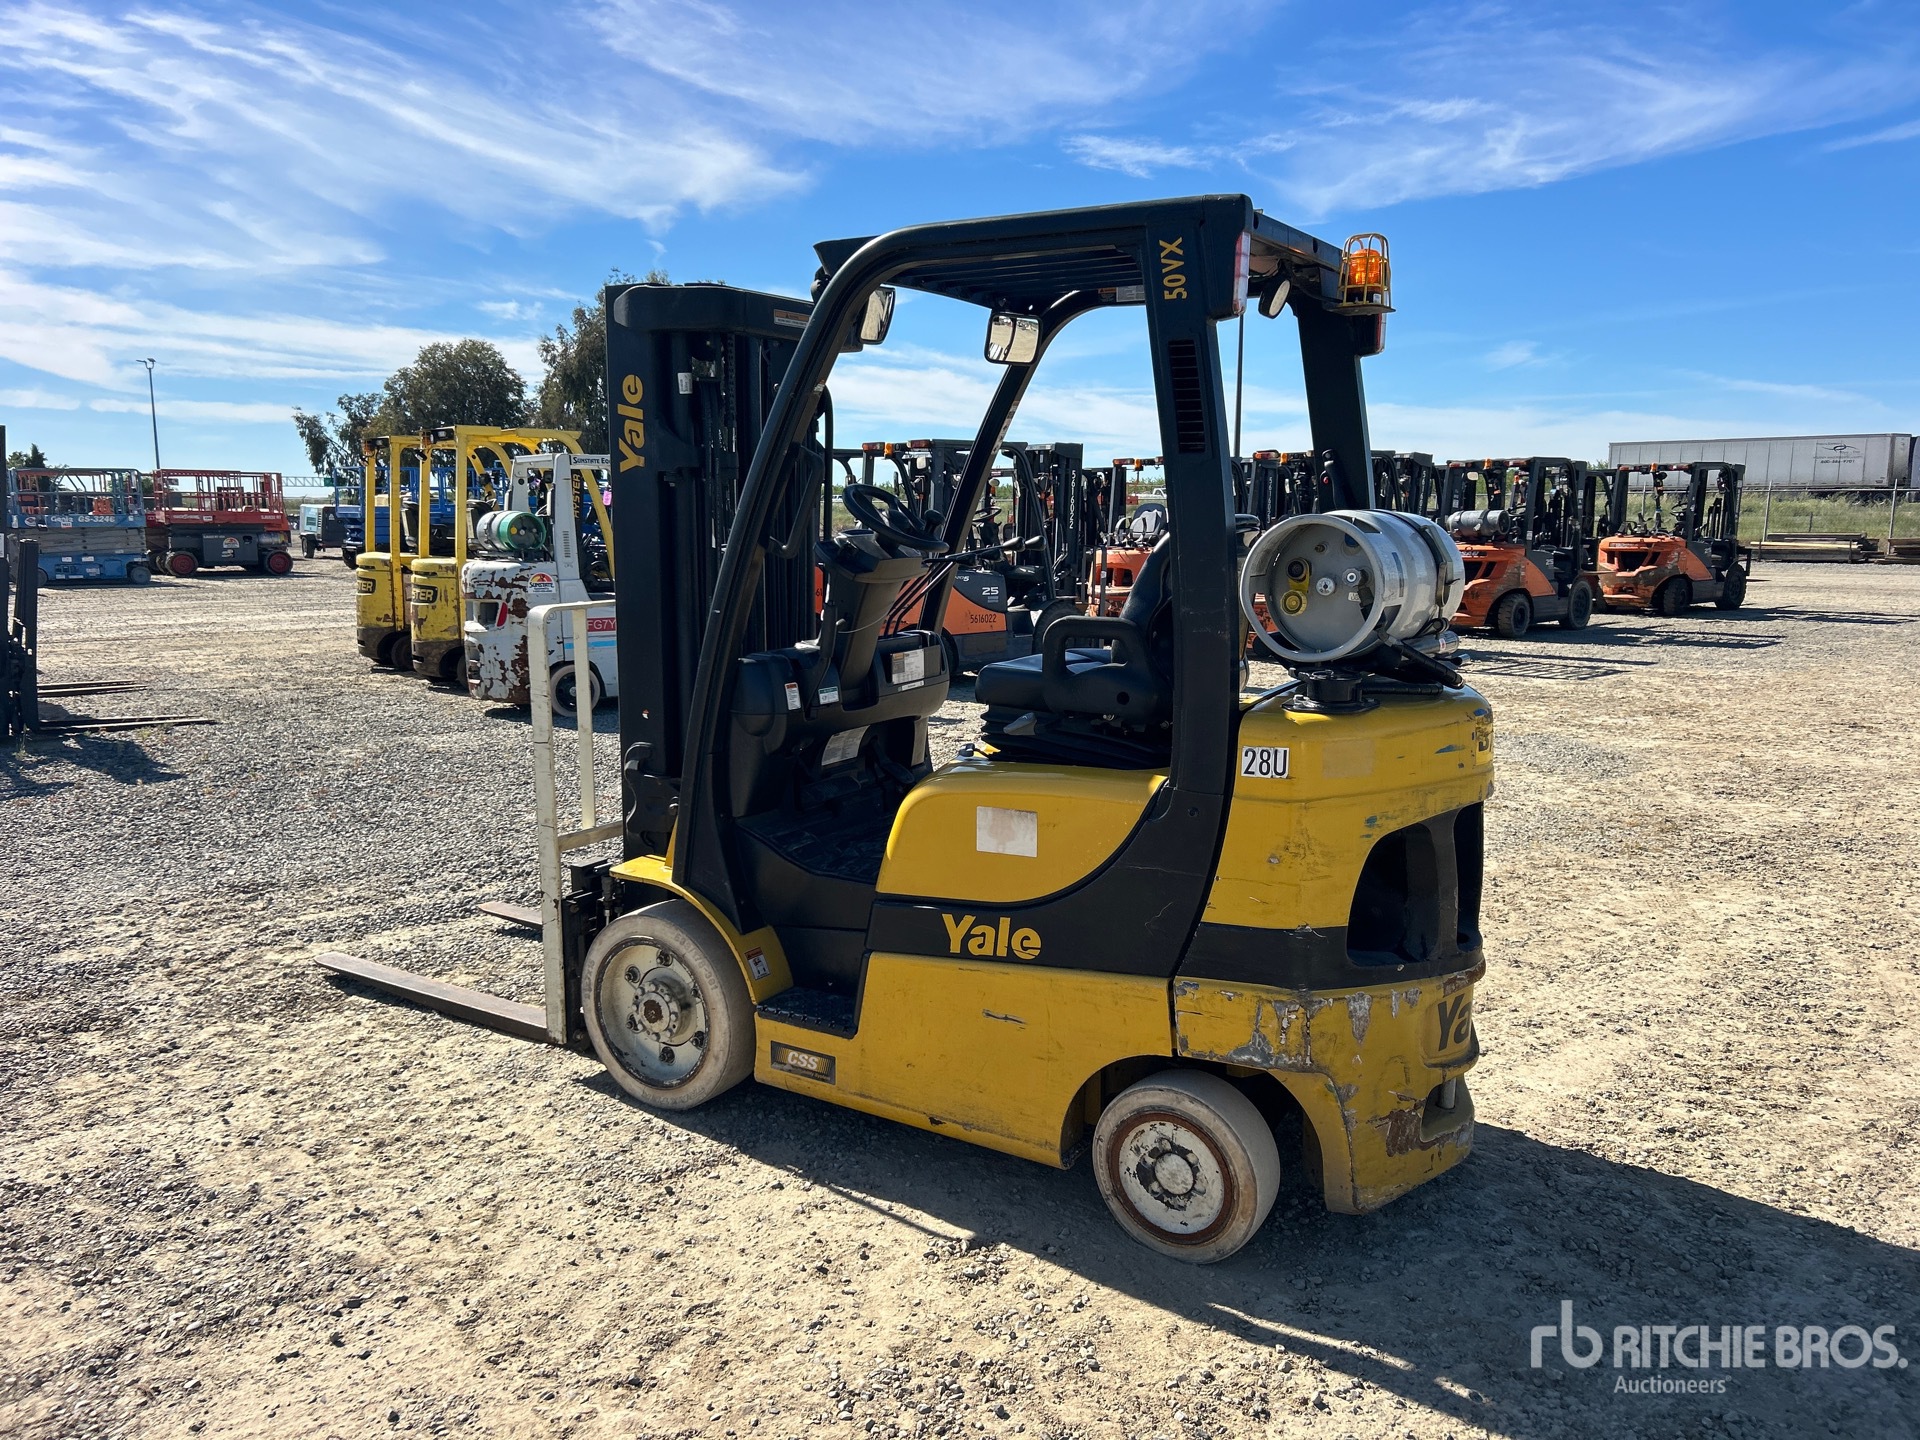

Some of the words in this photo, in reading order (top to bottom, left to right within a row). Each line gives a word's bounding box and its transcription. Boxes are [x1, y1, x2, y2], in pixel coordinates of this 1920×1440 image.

[1159, 237, 1187, 299] 50VX
[617, 374, 645, 473] Yale
[982, 586, 999, 596] 25
[970, 613, 997, 624] 5616022
[1243, 748, 1288, 776] 28U
[941, 913, 1042, 960] Yale
[788, 1051, 818, 1070] CSS
